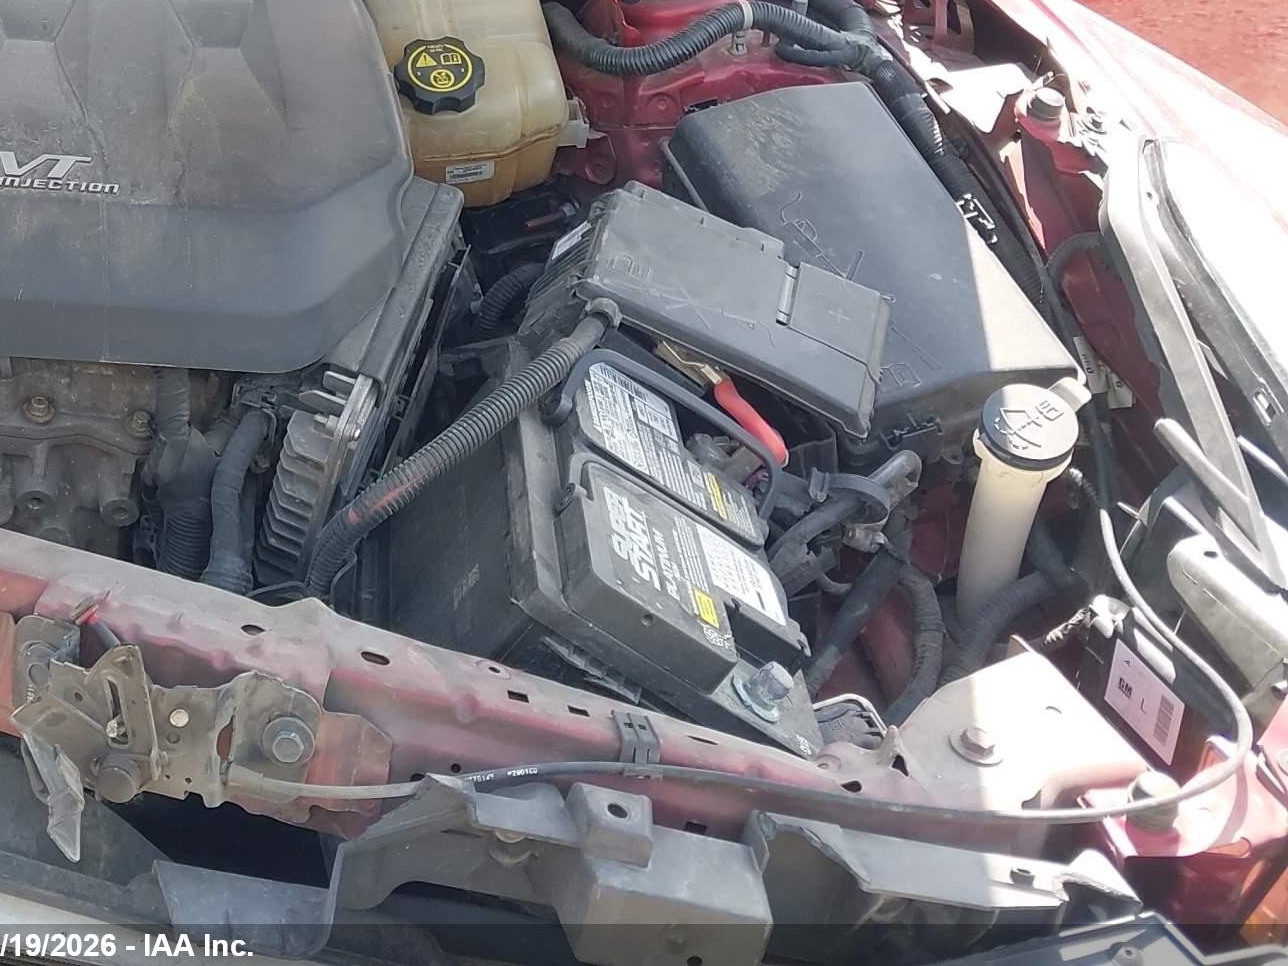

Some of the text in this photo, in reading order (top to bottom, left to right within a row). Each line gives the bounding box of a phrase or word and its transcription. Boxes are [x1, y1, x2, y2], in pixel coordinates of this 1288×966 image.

[604, 486, 632, 561] SUPER
[622, 497, 661, 592] START
[652, 527, 680, 602] PLATINUM
